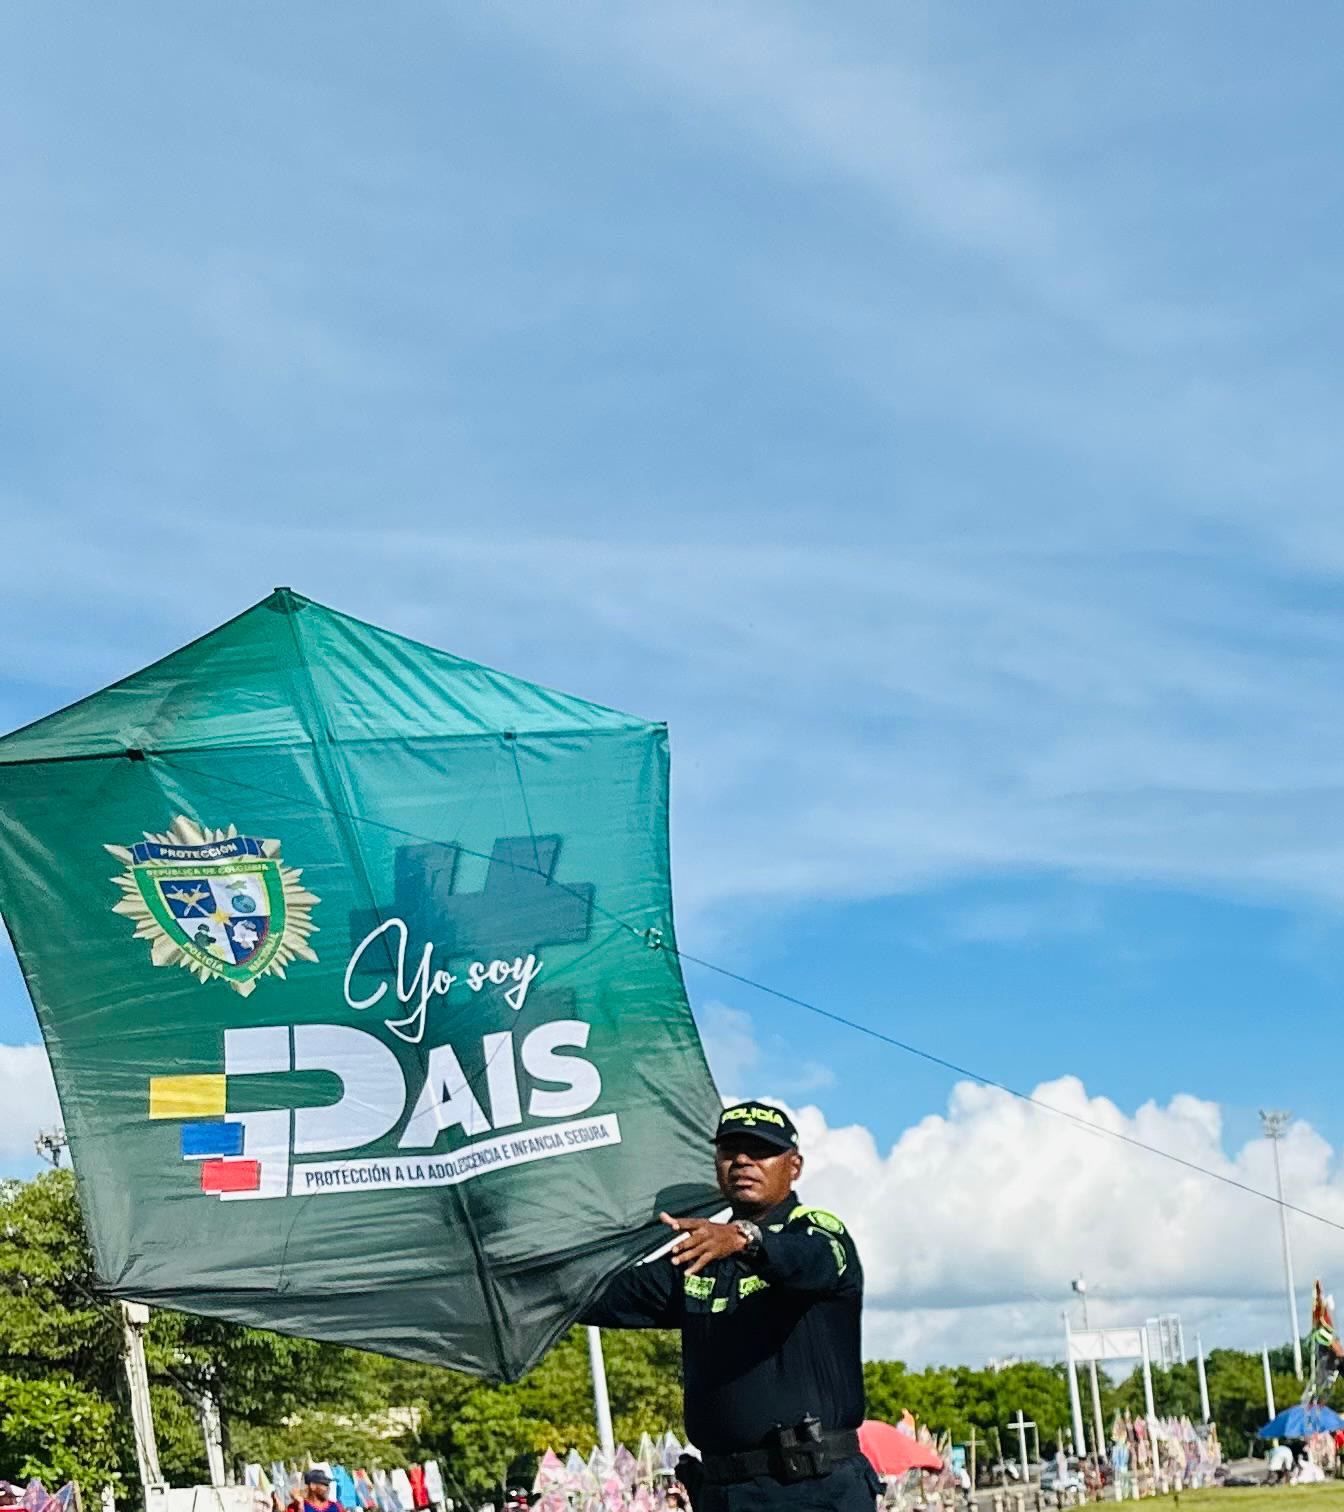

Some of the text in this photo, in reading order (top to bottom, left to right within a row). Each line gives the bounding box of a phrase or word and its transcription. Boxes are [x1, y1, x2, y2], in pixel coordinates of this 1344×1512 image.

[344, 918, 545, 1043] Yo soy
[221, 1019, 603, 1200] PAIS
[306, 1123, 609, 1187] PROTECCIÓN A LA ADOLESCENCIA E INFANCIA SEGURA
